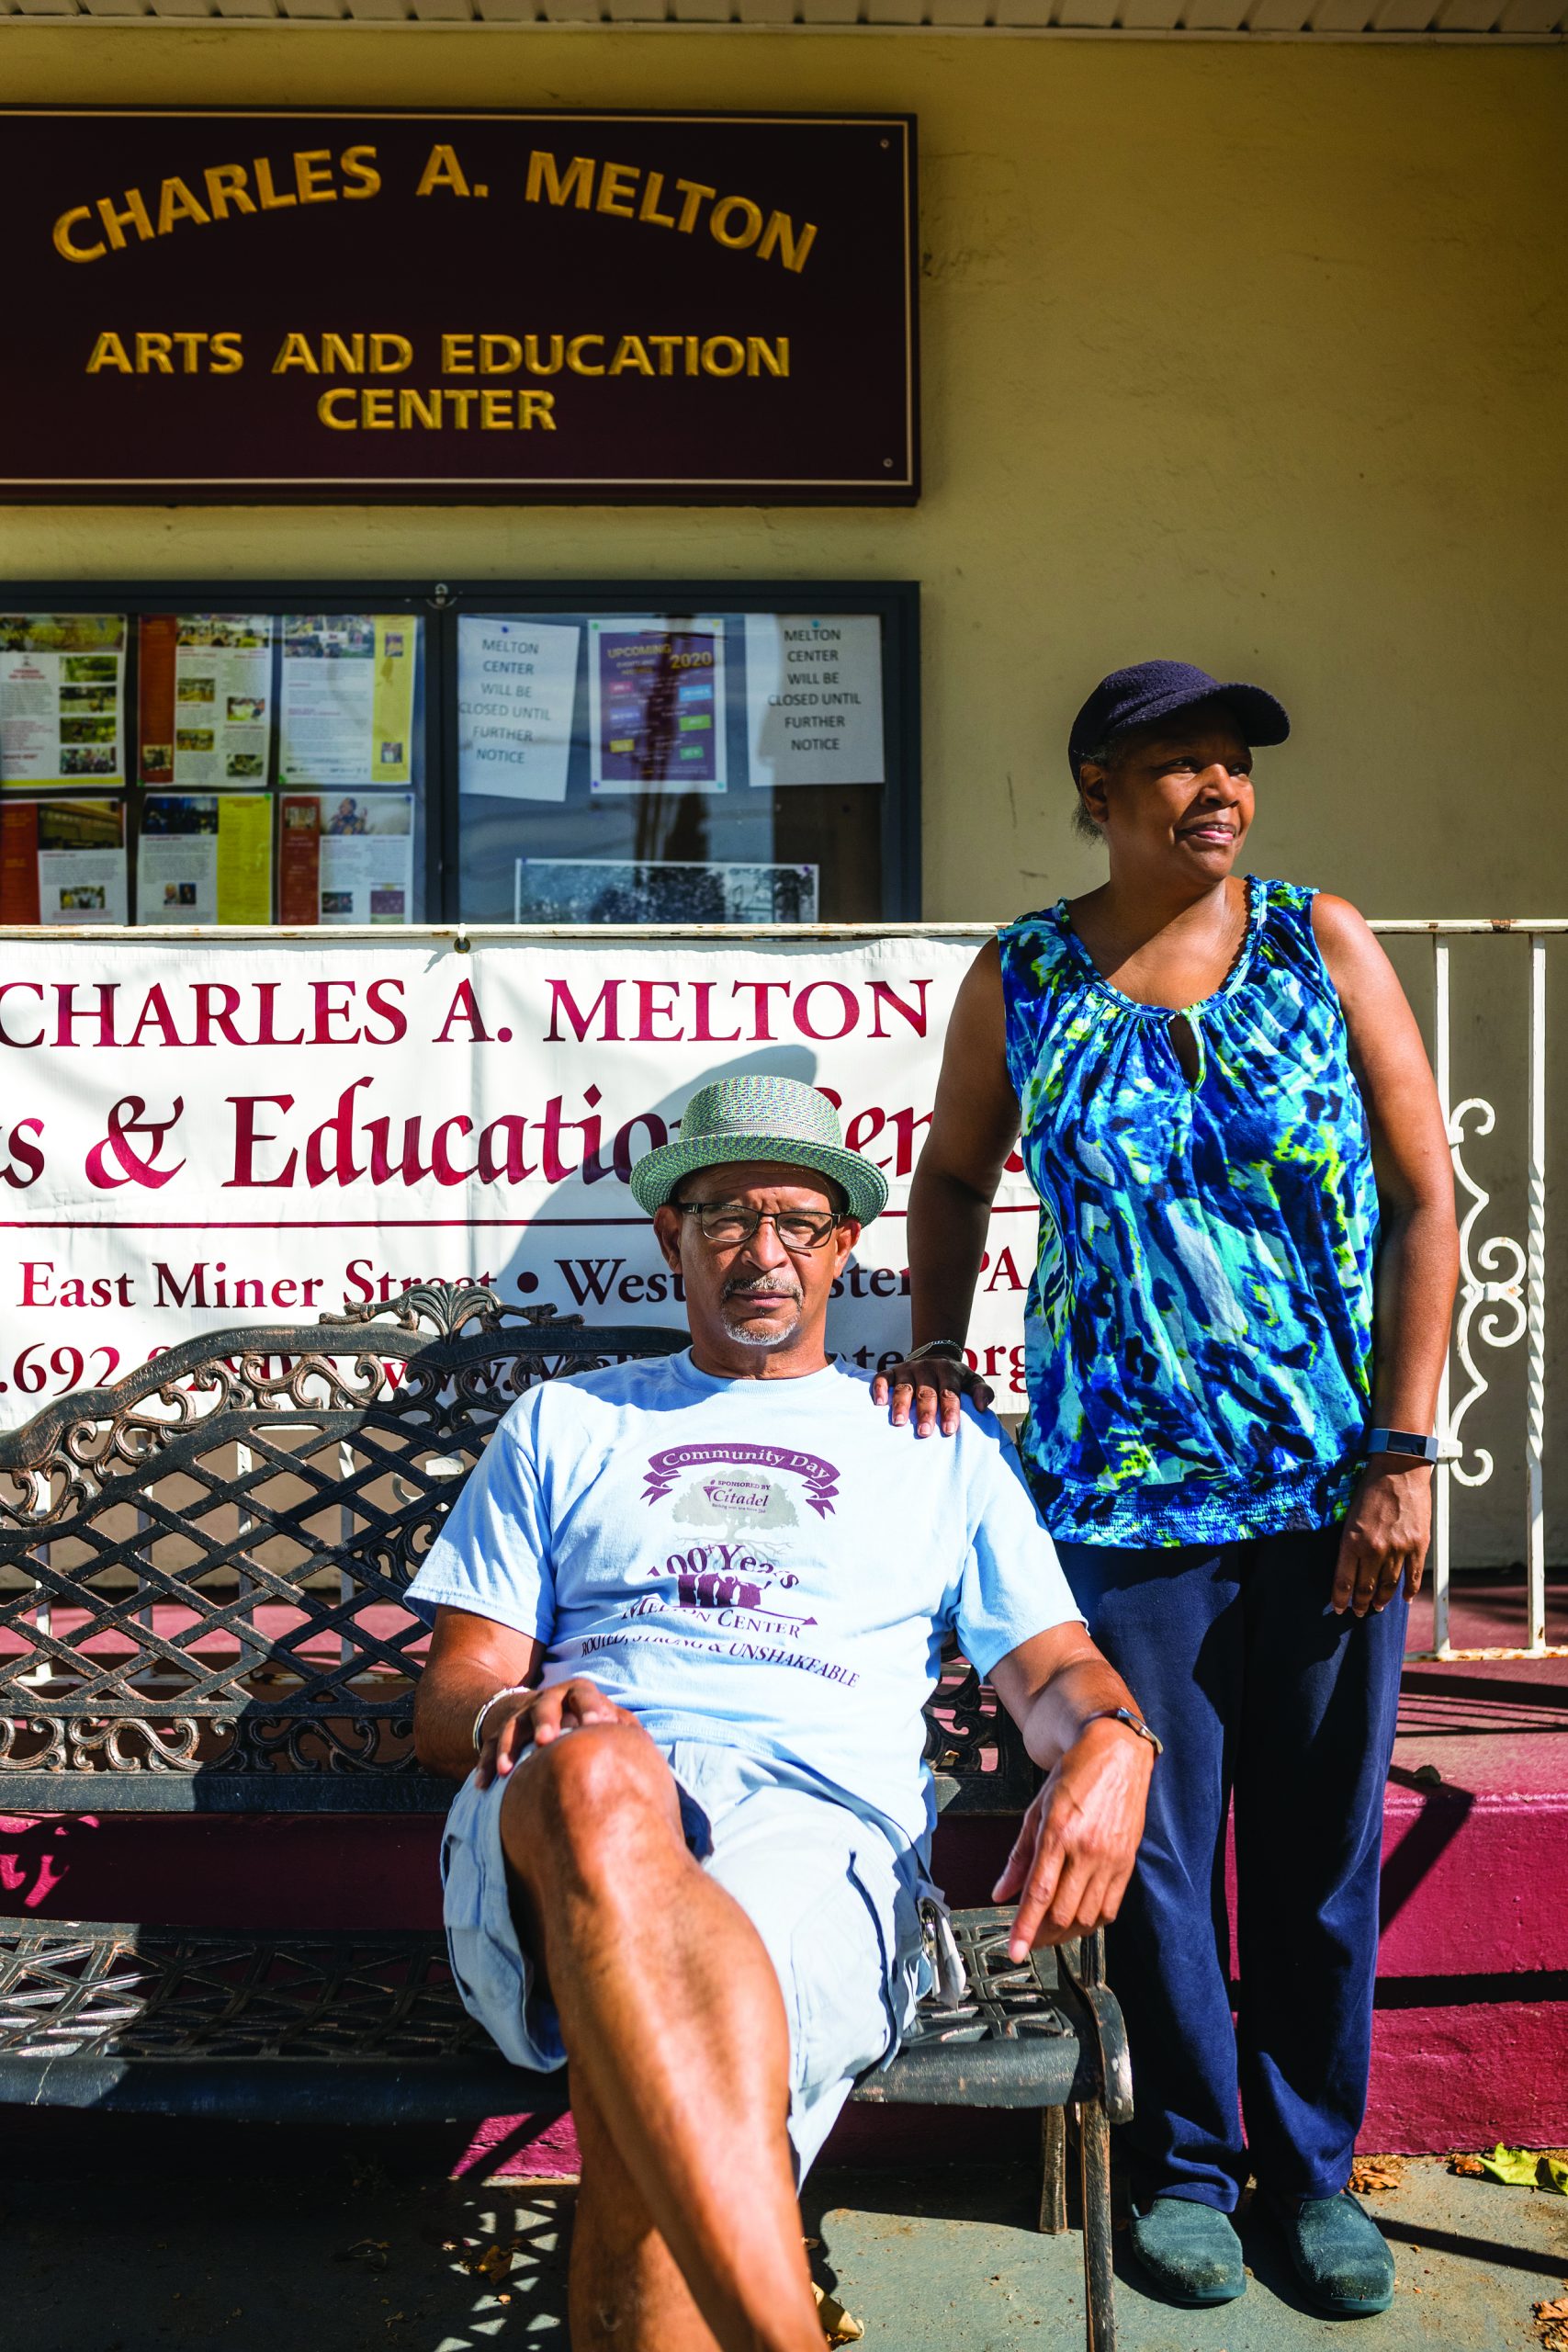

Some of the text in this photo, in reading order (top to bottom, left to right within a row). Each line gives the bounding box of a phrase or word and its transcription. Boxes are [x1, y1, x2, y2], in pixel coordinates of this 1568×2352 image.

[52, 144, 818, 273] CHARLES A. MELTON
[86, 332, 791, 377] ARTS AND EDUCATION
[316, 388, 558, 431] CENTER
[784, 628, 841, 641] MELTON
[481, 639, 540, 655] MELTON
[607, 643, 671, 659] UPCOMING
[786, 649, 840, 662] CENTER
[482, 661, 535, 675] CENTER
[669, 650, 713, 669] 2020
[786, 672, 840, 685] WILL BE
[480, 683, 532, 698] WILL BE
[767, 693, 862, 707] CLOSED UNTIL
[458, 702, 552, 720] CLOSED UNTIL
[784, 716, 846, 729] FURTHER
[473, 725, 534, 742] FURTHER
[790, 738, 840, 751] NOTICE
[476, 748, 526, 764] NOTICE
[0, 978, 933, 1049] CHARLES A. MELTON
[0, 1117, 45, 1190] s
[85, 1095, 187, 1190] &
[220, 1076, 683, 1189] Educatio
[16, 1261, 135, 1307] East
[152, 1261, 324, 1308] Miner
[553, 1258, 687, 1306] West
[662, 1448, 831, 1480] Community Day
[717, 1480, 760, 1489] SPONSORED
[713, 1487, 769, 1507] Citadel
[717, 1609, 801, 1639] CENTER
[729, 1642, 861, 1688] UNSHAKEABLE
